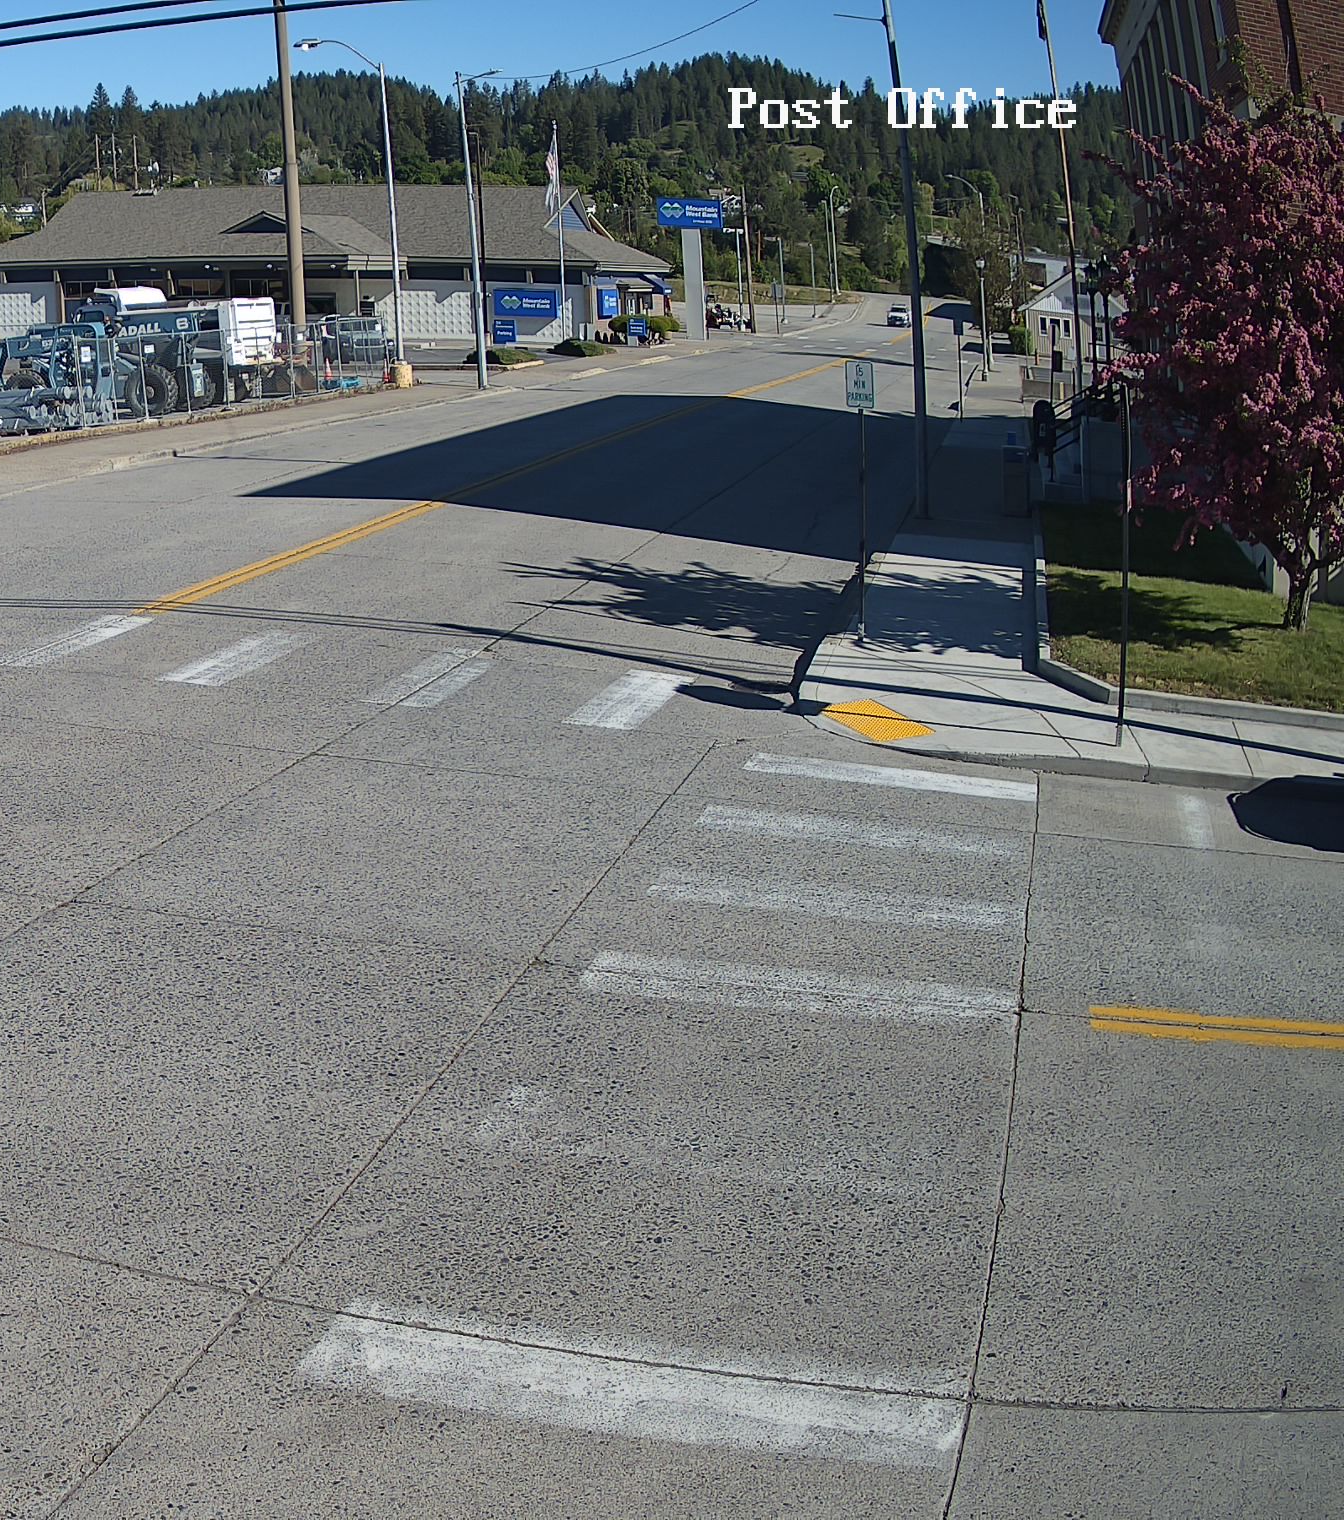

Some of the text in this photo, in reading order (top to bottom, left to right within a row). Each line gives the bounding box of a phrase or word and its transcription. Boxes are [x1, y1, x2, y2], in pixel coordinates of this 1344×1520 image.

[118, 322, 161, 337] ADALL
[853, 380, 866, 389] MIN
[848, 392, 873, 402] PARKING
